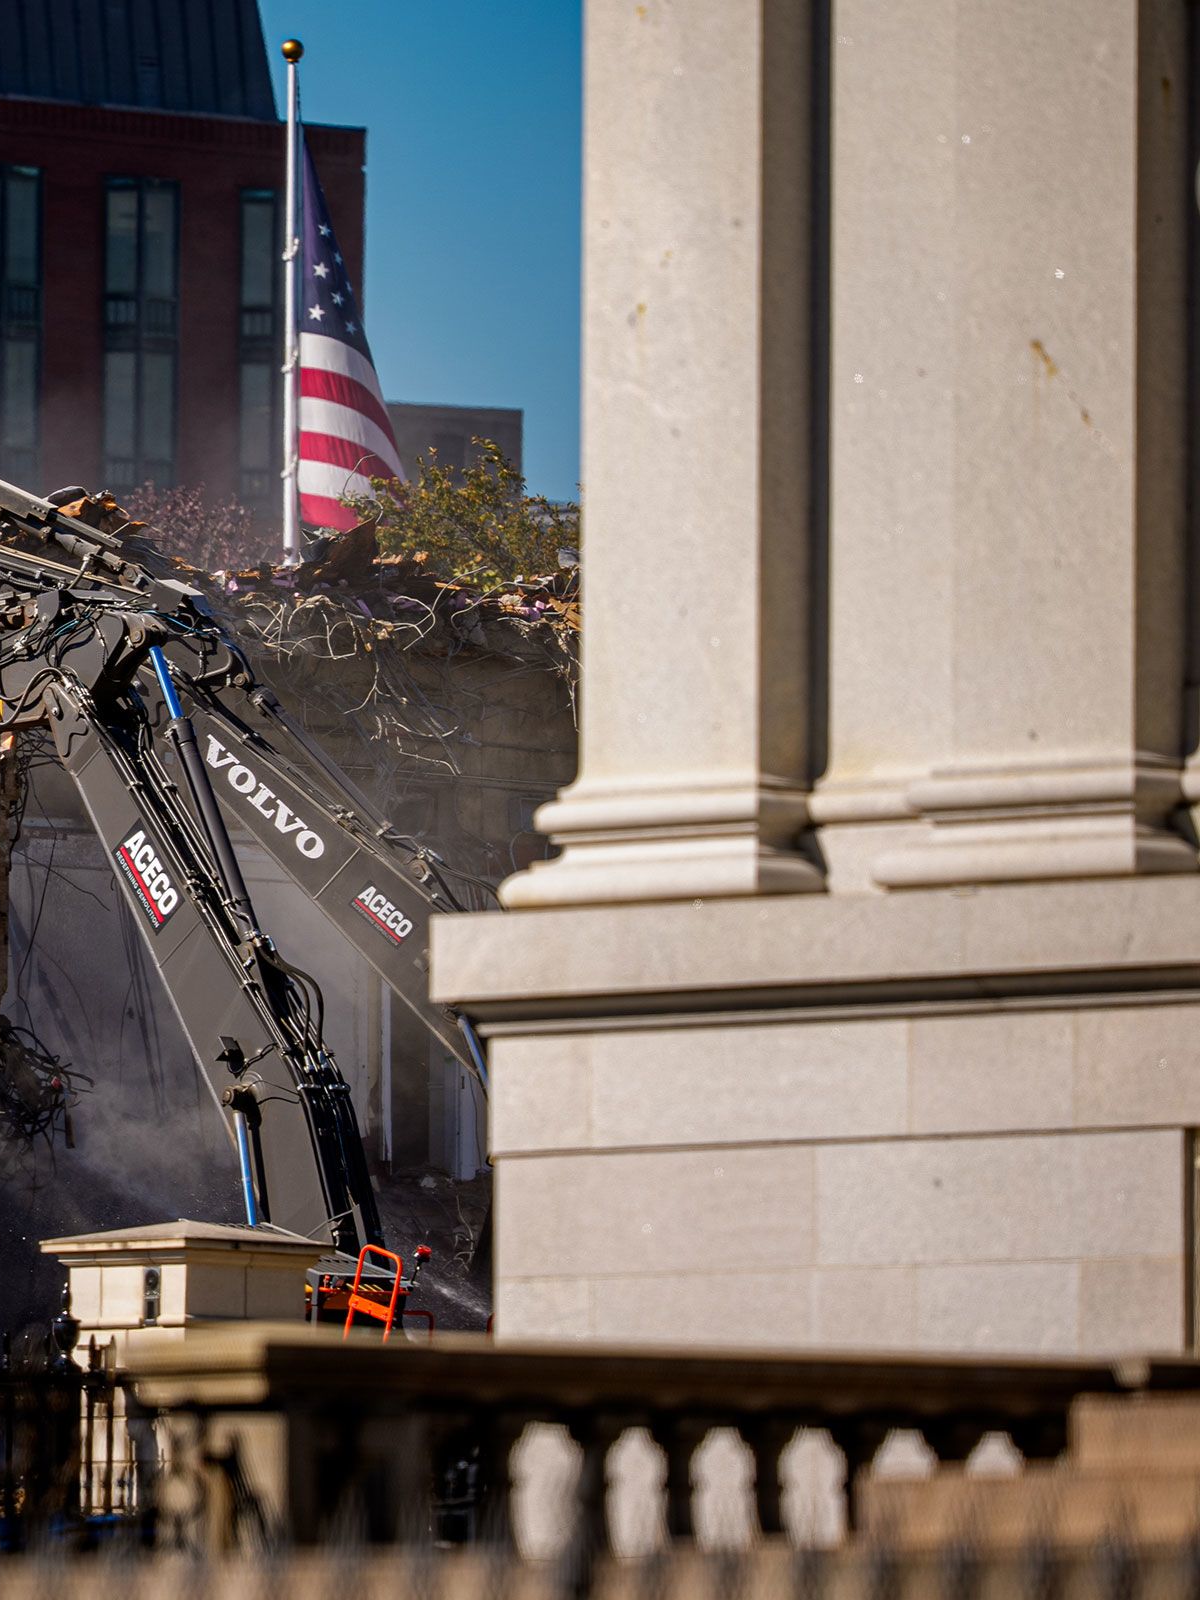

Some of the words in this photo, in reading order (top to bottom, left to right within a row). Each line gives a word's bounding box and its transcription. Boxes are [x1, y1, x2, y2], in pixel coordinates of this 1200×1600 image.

[206, 734, 325, 859] VOLVO
[115, 850, 138, 889] REDEFINING
[136, 887, 160, 928] DEMOLITION
[124, 830, 178, 915] ACECO
[357, 886, 413, 938] ACECO
